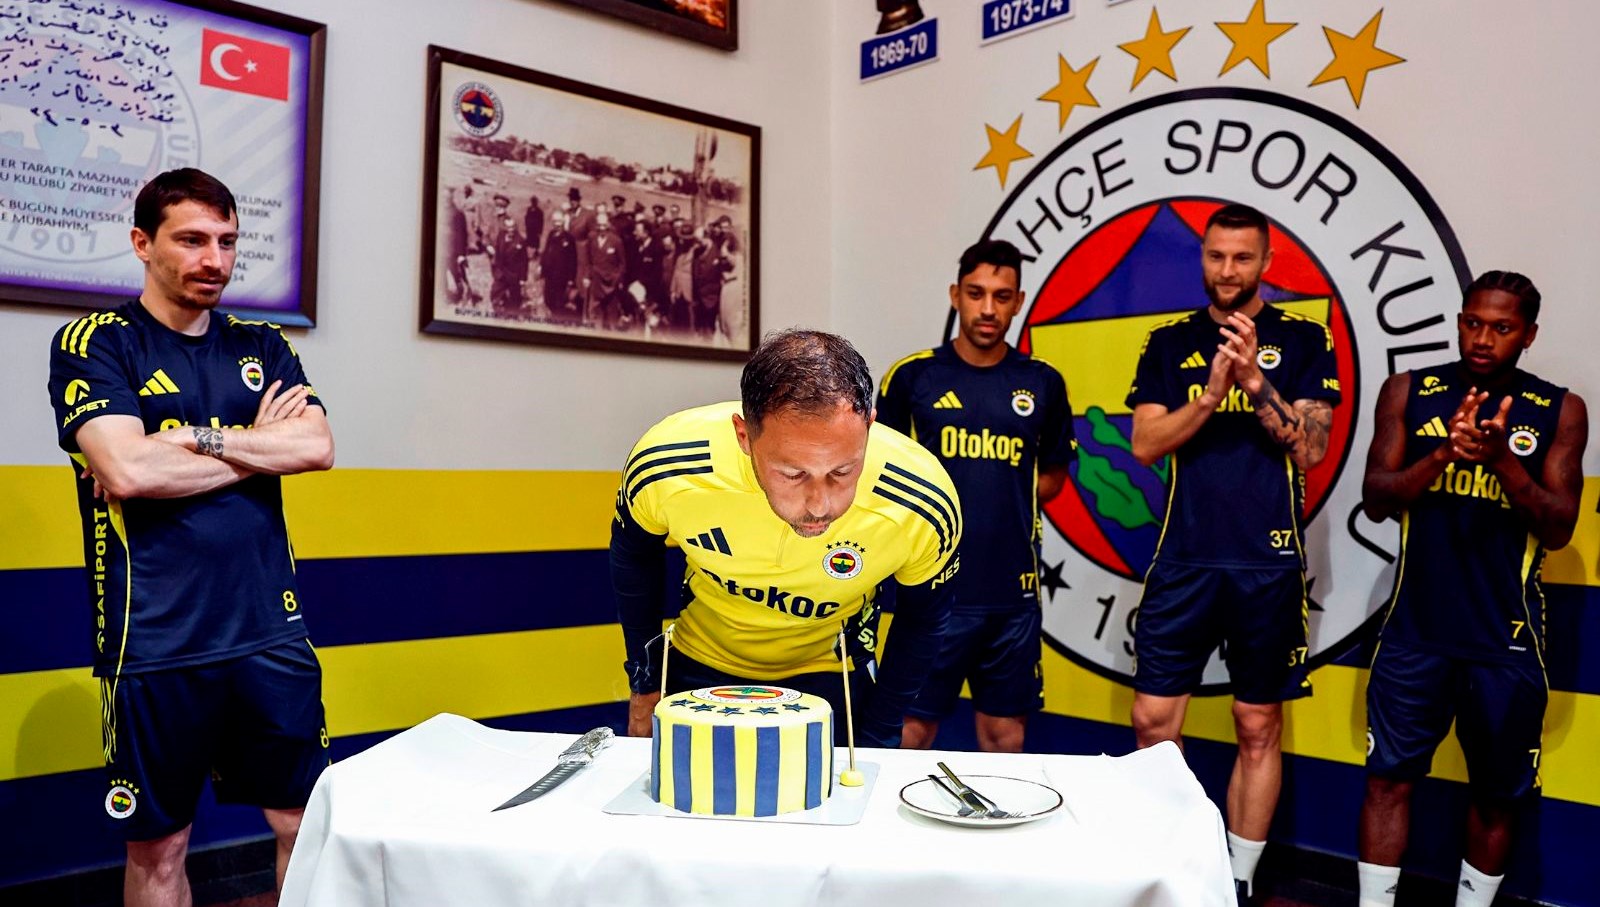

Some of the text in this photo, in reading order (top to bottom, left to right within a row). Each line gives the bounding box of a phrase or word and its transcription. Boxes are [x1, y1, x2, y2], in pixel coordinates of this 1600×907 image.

[870, 31, 928, 69] 1969-70
[21, 161, 75, 178] TARAFTA
[1164, 119, 1358, 225] SPOR
[7, 222, 97, 255] 1907
[63, 398, 110, 428] ALPET
[941, 425, 1023, 466] Otokoç
[1269, 529, 1292, 548] 37
[931, 552, 961, 590] NES
[1019, 572, 1036, 590] 17
[282, 590, 297, 612] 8
[1511, 620, 1525, 639] 7
[1288, 646, 1308, 667] 37
[319, 726, 330, 748] 8
[1529, 748, 1541, 768] 7
